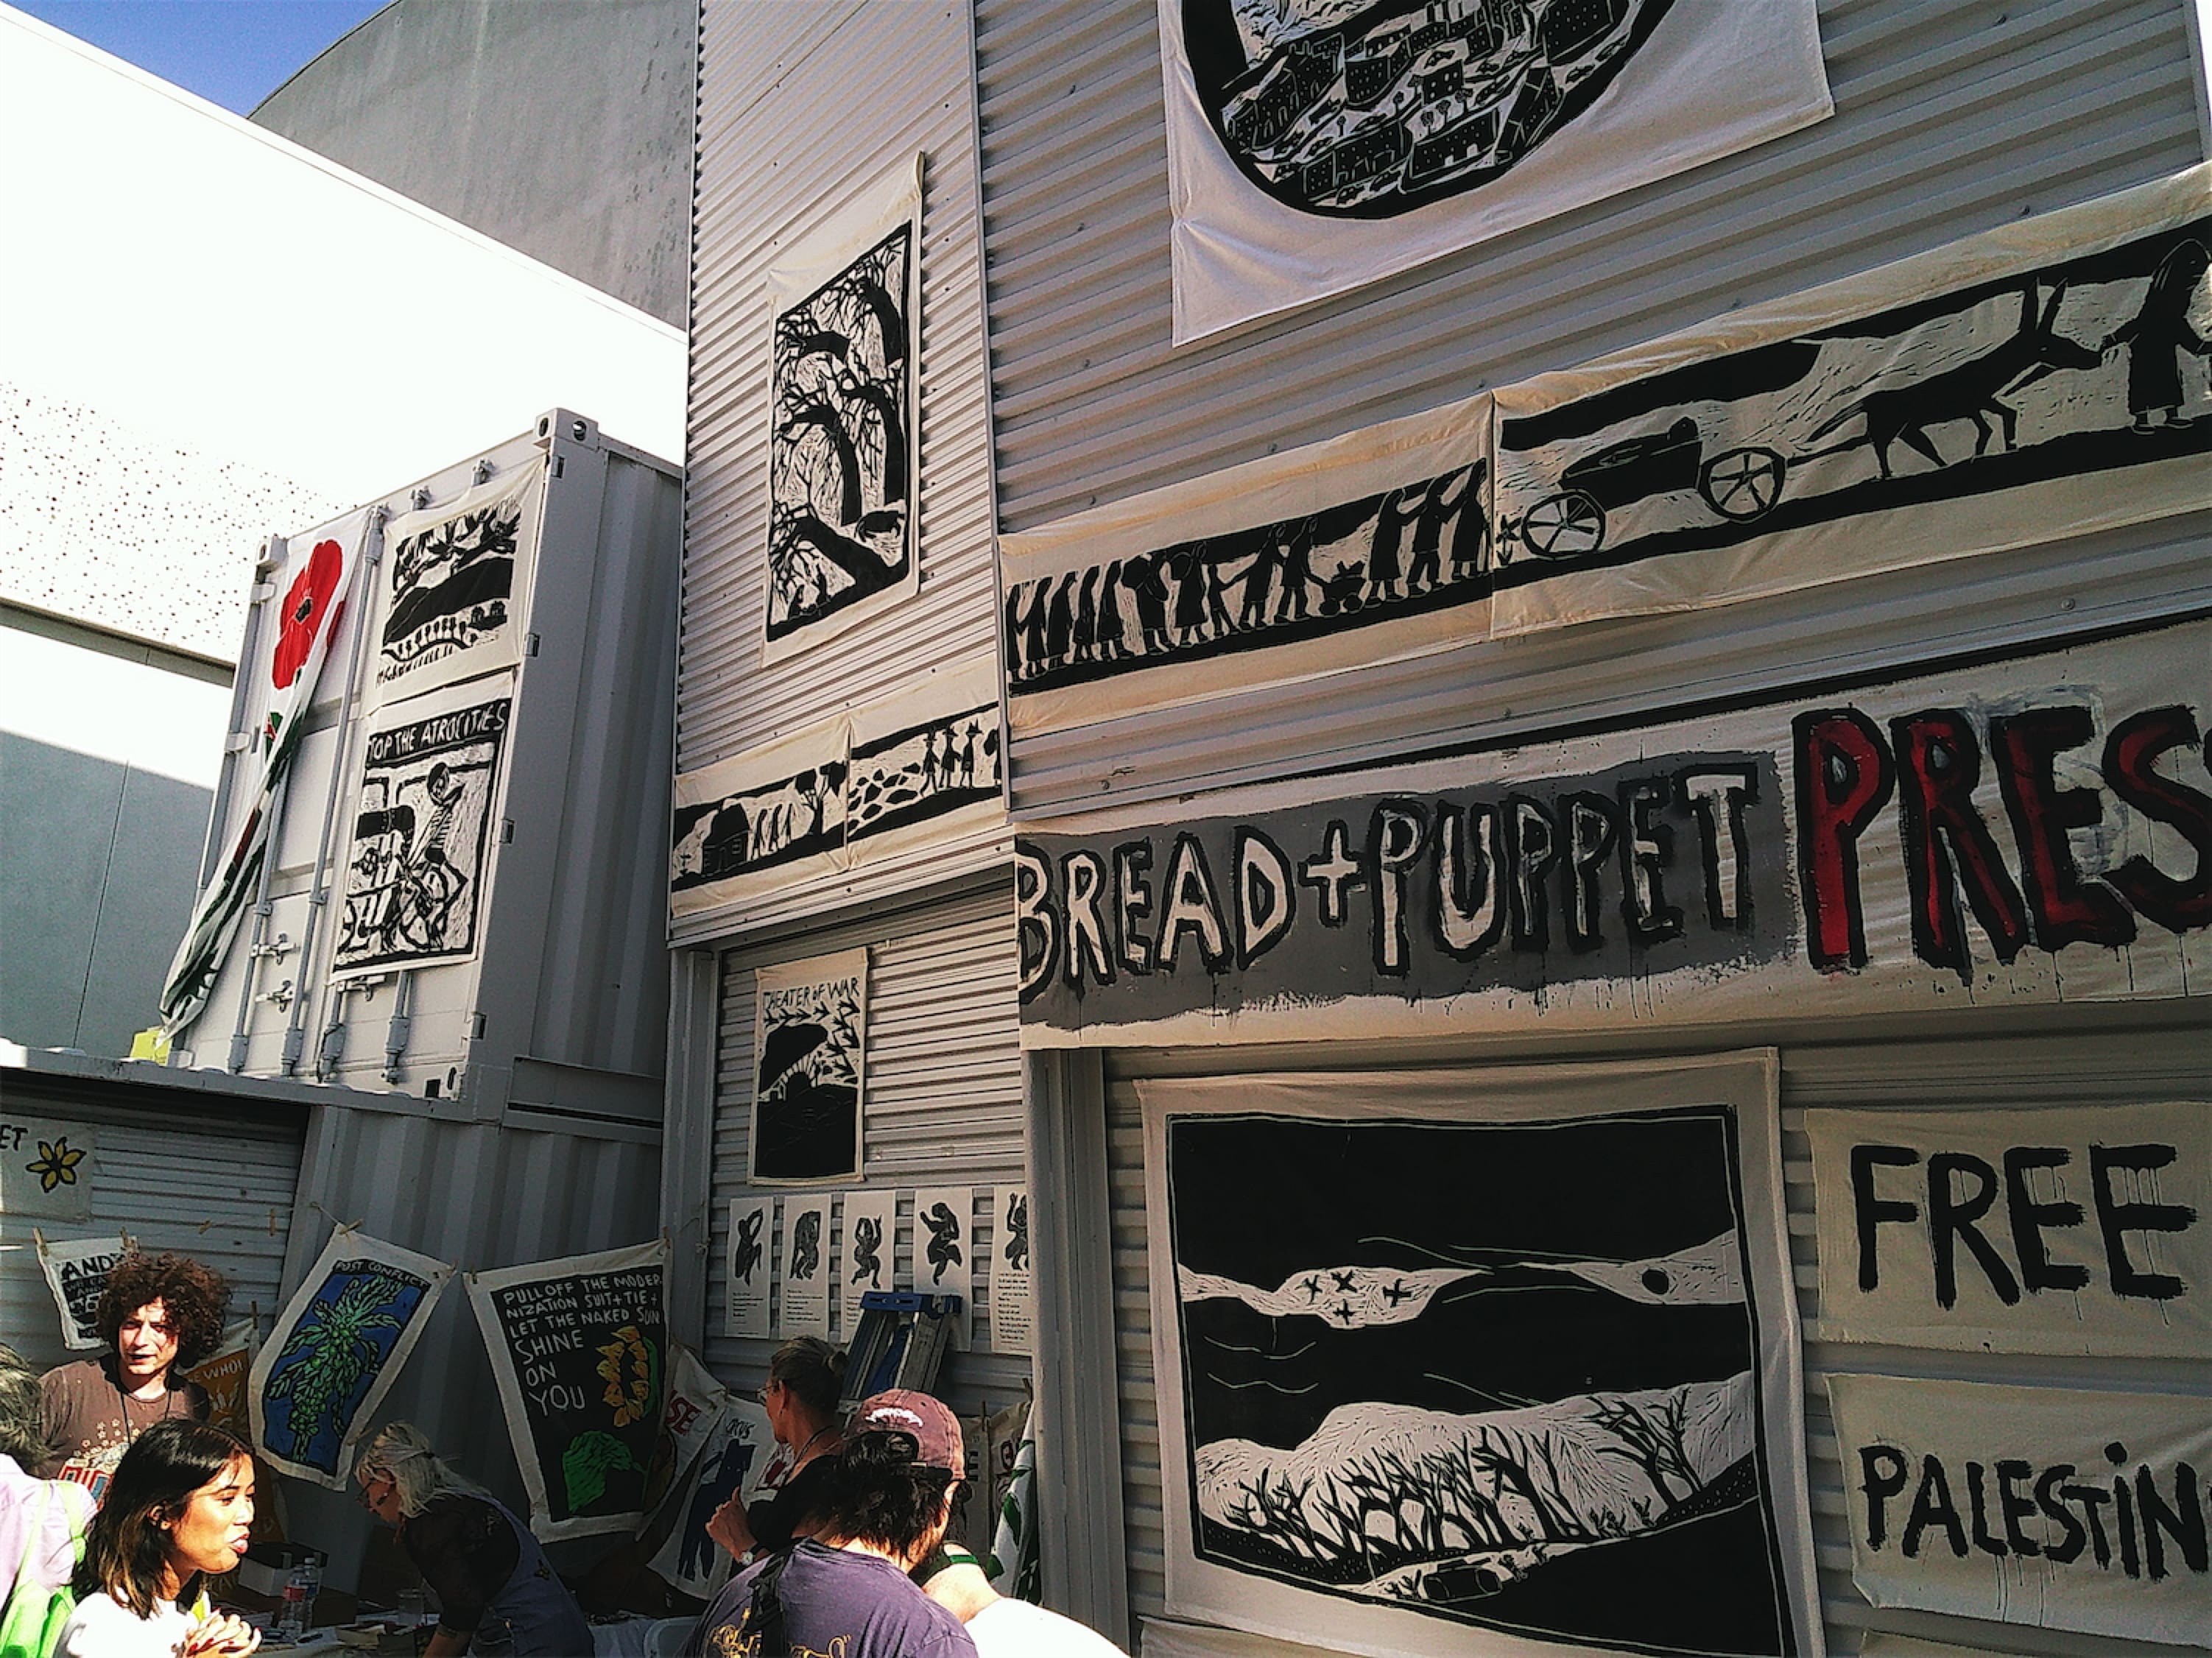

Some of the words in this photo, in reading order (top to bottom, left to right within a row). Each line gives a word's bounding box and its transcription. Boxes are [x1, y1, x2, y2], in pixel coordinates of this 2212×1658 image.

[395, 727, 417, 755] THE
[420, 702, 507, 747] ATROCITIES
[1015, 825, 1297, 1004] BREAD
[1368, 762, 1759, 975] PUPPET
[1790, 703, 2212, 976] PRES
[762, 986, 810, 1009] THEATER
[828, 977, 859, 1000] WAR
[1850, 1140, 2197, 1310] FREE
[336, 1260, 364, 1271] POST
[368, 1261, 429, 1287] CONFLICT
[580, 1276, 610, 1292] THE
[506, 1297, 578, 1319] NIZATION
[509, 1318, 538, 1338] LET
[545, 1312, 576, 1329] THE
[581, 1308, 630, 1325] NAKED
[636, 1306, 661, 1325] SUN
[515, 1329, 584, 1365] SHINE
[525, 1361, 557, 1387] ON
[528, 1384, 585, 1417] YOU
